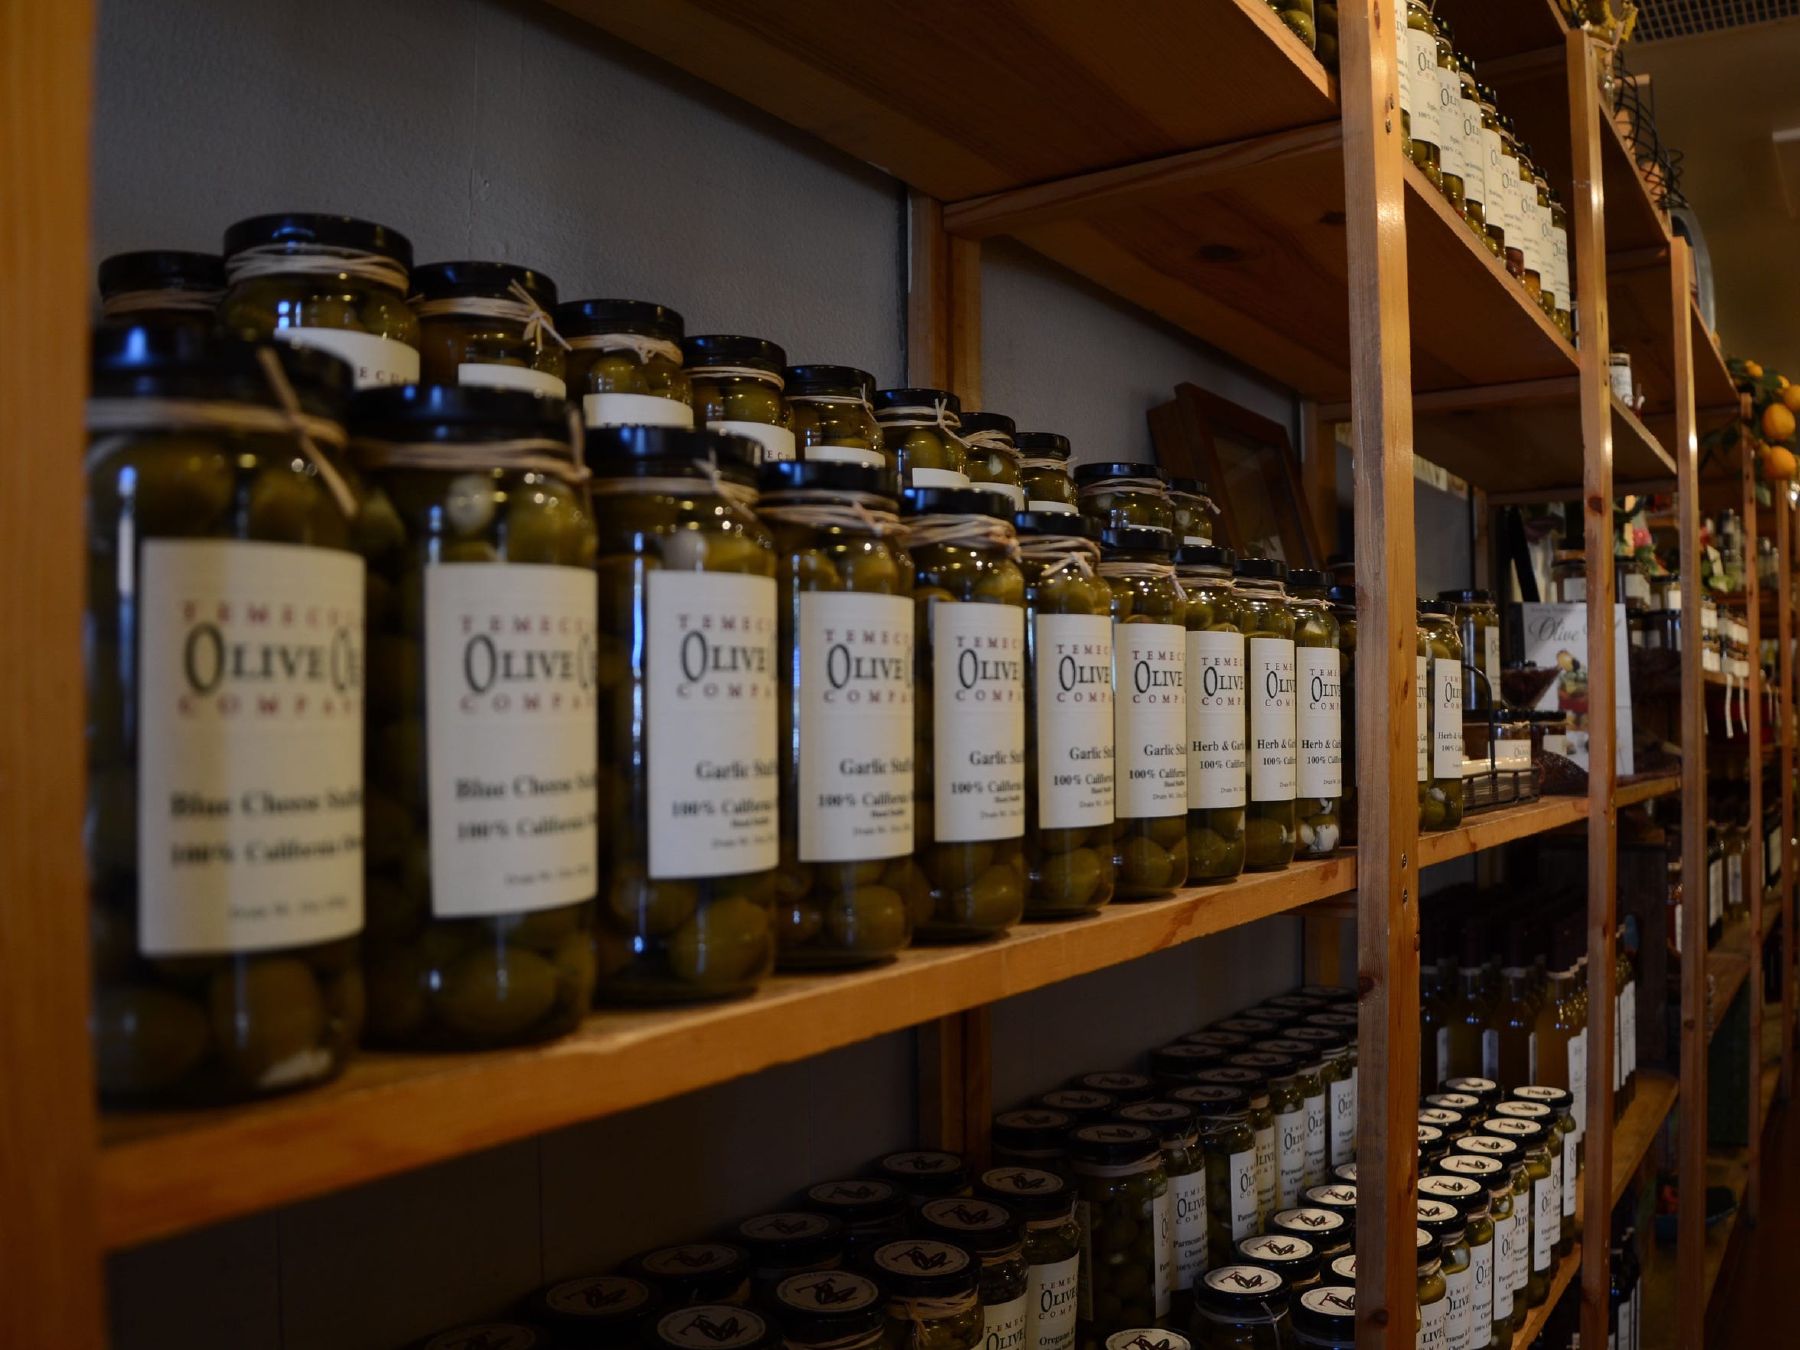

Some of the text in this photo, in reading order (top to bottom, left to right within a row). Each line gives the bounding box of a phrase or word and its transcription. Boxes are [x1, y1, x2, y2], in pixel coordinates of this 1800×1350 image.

[184, 622, 322, 697] OLIVE
[464, 633, 574, 693] OLIVE
[681, 630, 765, 682] OLIVE
[827, 643, 902, 689] OLIVE
[959, 649, 1018, 689] OLIVE
[1059, 655, 1111, 691] OLIVE
[1134, 660, 1183, 694] OLIVE
[1203, 666, 1243, 696] OLIVE
[1144, 744, 1173, 756] Garlic
[1192, 740, 1219, 751] Herb
[1221, 741, 1229, 751] &
[1257, 739, 1279, 749] Herb
[1281, 740, 1287, 749] &
[1302, 739, 1323, 749] Herb
[1325, 740, 1331, 749] &
[970, 750, 1006, 766] Garlic
[1070, 746, 1101, 760] Garlic
[1307, 756, 1325, 765] 100%
[839, 759, 886, 775] Garlic
[1200, 760, 1222, 770] 100%
[1263, 757, 1281, 766] 100%
[1053, 775, 1082, 786] 100%
[1129, 768, 1155, 779] 100%
[951, 781, 983, 795] 100%
[1177, 1197, 1205, 1217] OLIVE
[1041, 1287, 1076, 1312] OLIVE
[986, 1329, 1024, 1350] OLIVE
